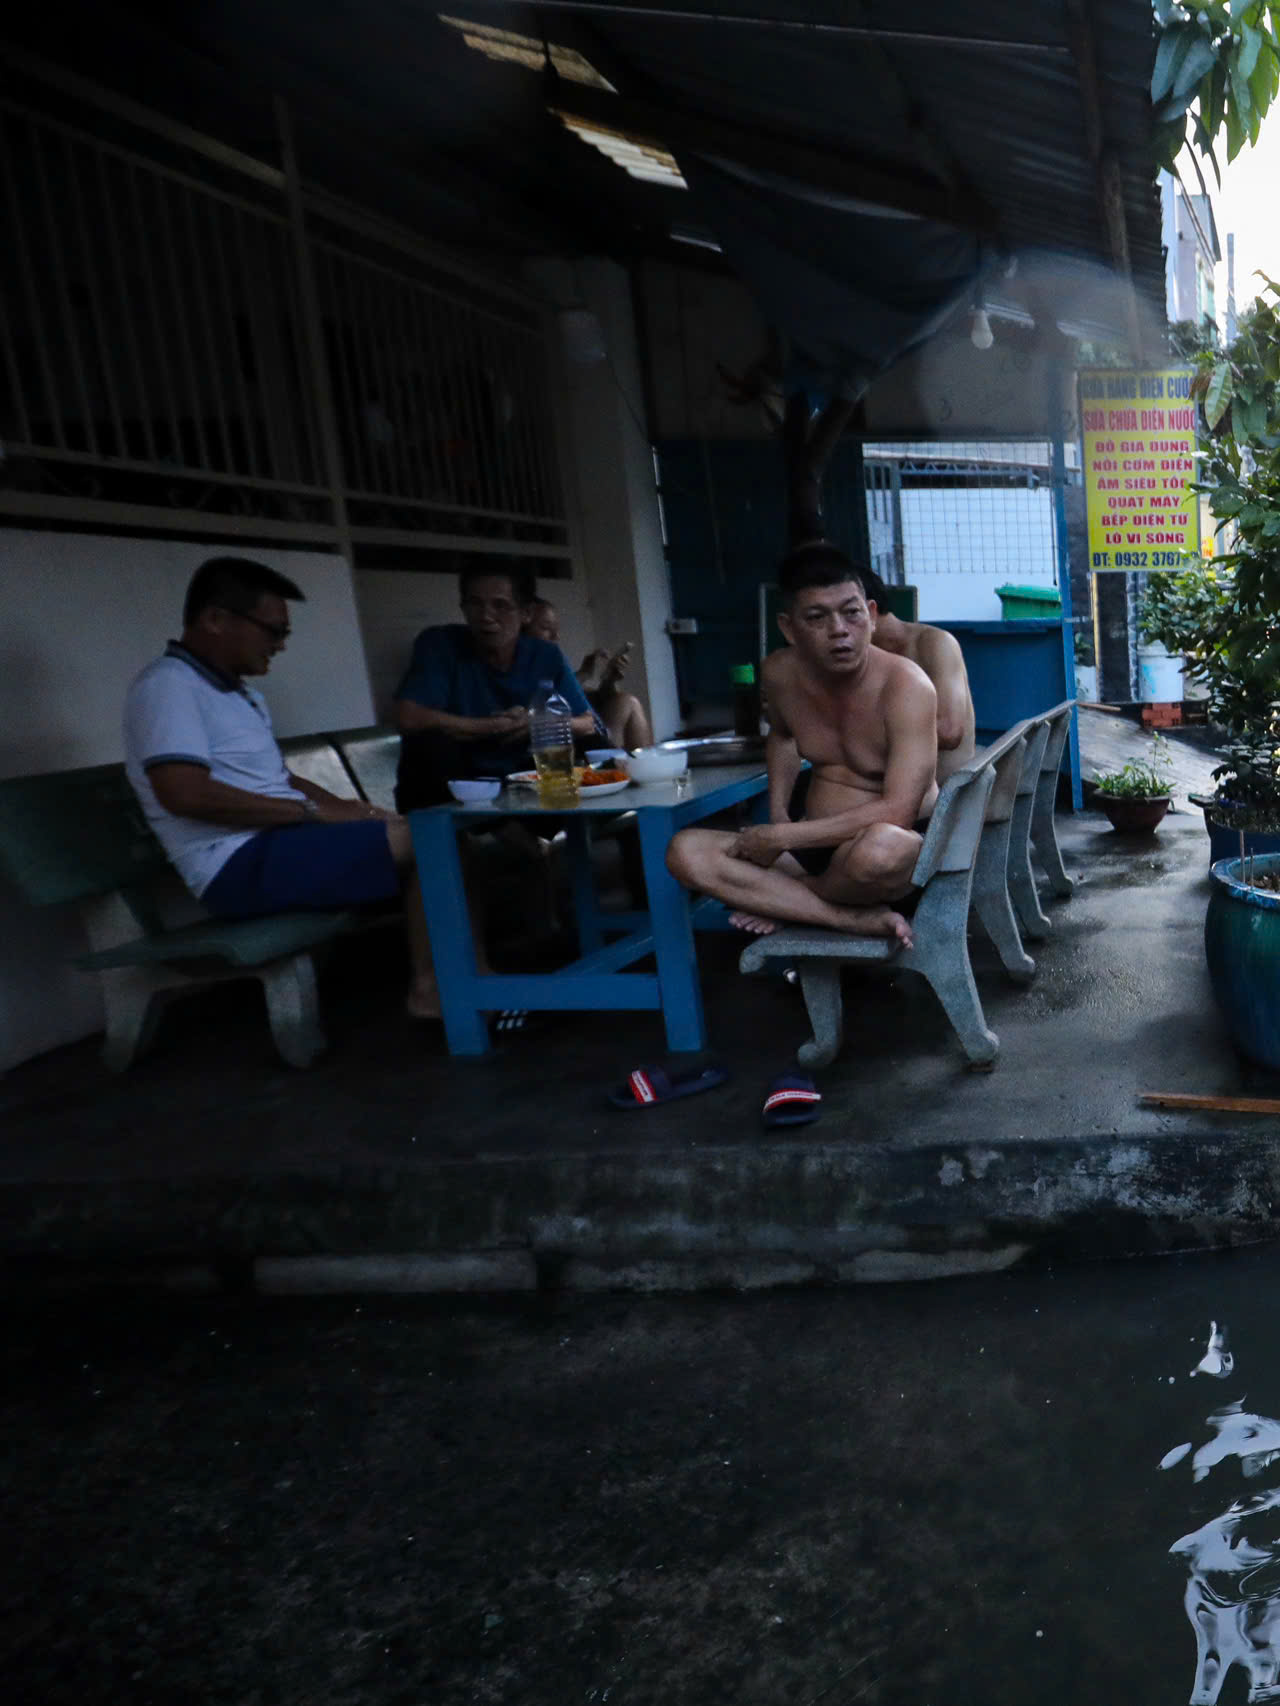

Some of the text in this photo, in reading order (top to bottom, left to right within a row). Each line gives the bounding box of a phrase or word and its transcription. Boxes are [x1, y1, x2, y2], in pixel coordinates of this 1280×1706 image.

[1084, 407, 1105, 432] SỬA
[1109, 407, 1138, 432] CHỮA
[1141, 406, 1164, 434] ĐIỆN
[1095, 438, 1115, 452] ĐỒ
[1120, 440, 1145, 452] GIA
[1092, 456, 1193, 472] NỒI CƠM ĐIỆN
[1125, 476, 1156, 489] SIÊU
[1102, 512, 1128, 526] BẾP
[1133, 513, 1165, 527] ĐIỆN
[1127, 533, 1141, 544] VI
[1093, 552, 1111, 567] ĐT:
[1115, 552, 1148, 567] 0932
